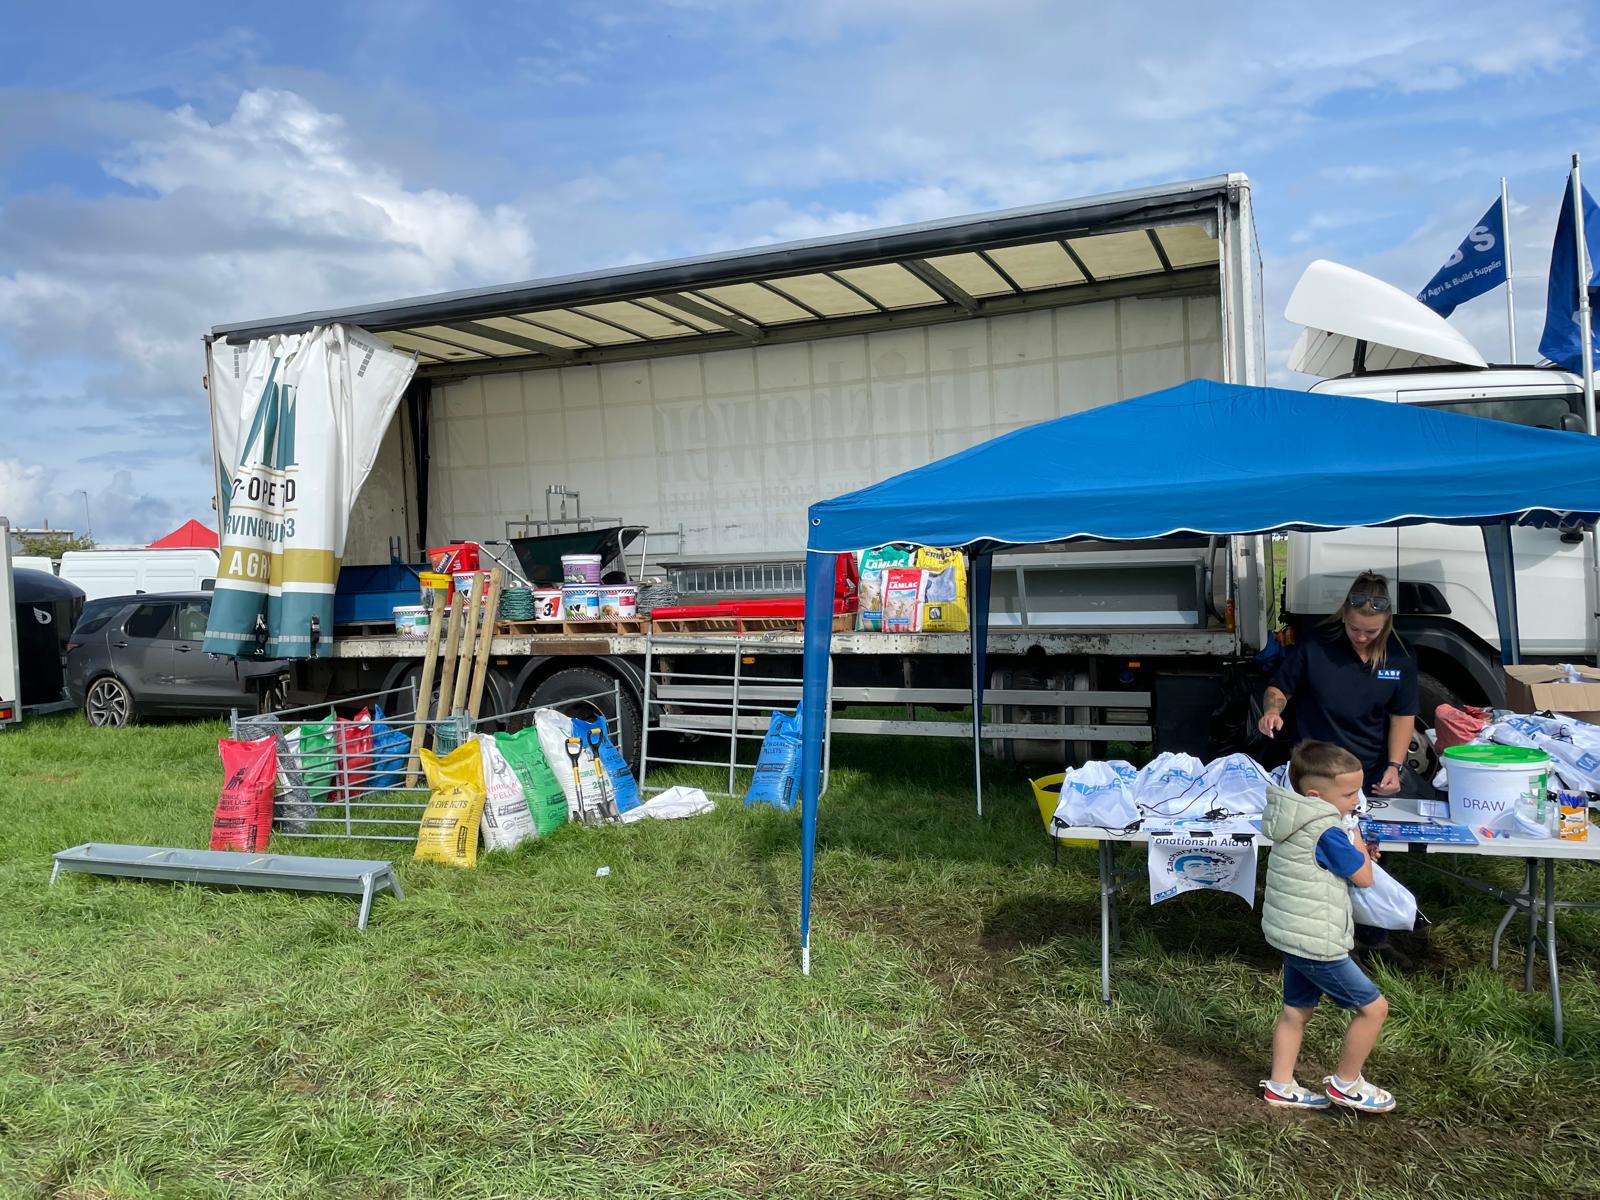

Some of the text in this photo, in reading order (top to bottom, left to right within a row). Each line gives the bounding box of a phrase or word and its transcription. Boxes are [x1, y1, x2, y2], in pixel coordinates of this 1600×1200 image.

[1428, 283, 1444, 298] Agri
[1444, 281, 1453, 289] &
[1452, 272, 1474, 285] Build
[1474, 260, 1502, 277] Supplies
[889, 581, 918, 589] LAMLAC
[435, 800, 450, 808] EWE
[1463, 797, 1506, 811] DRAW
[1153, 837, 1206, 847] onations
[1207, 838, 1217, 847] in
[1166, 848, 1192, 875] Zachary
